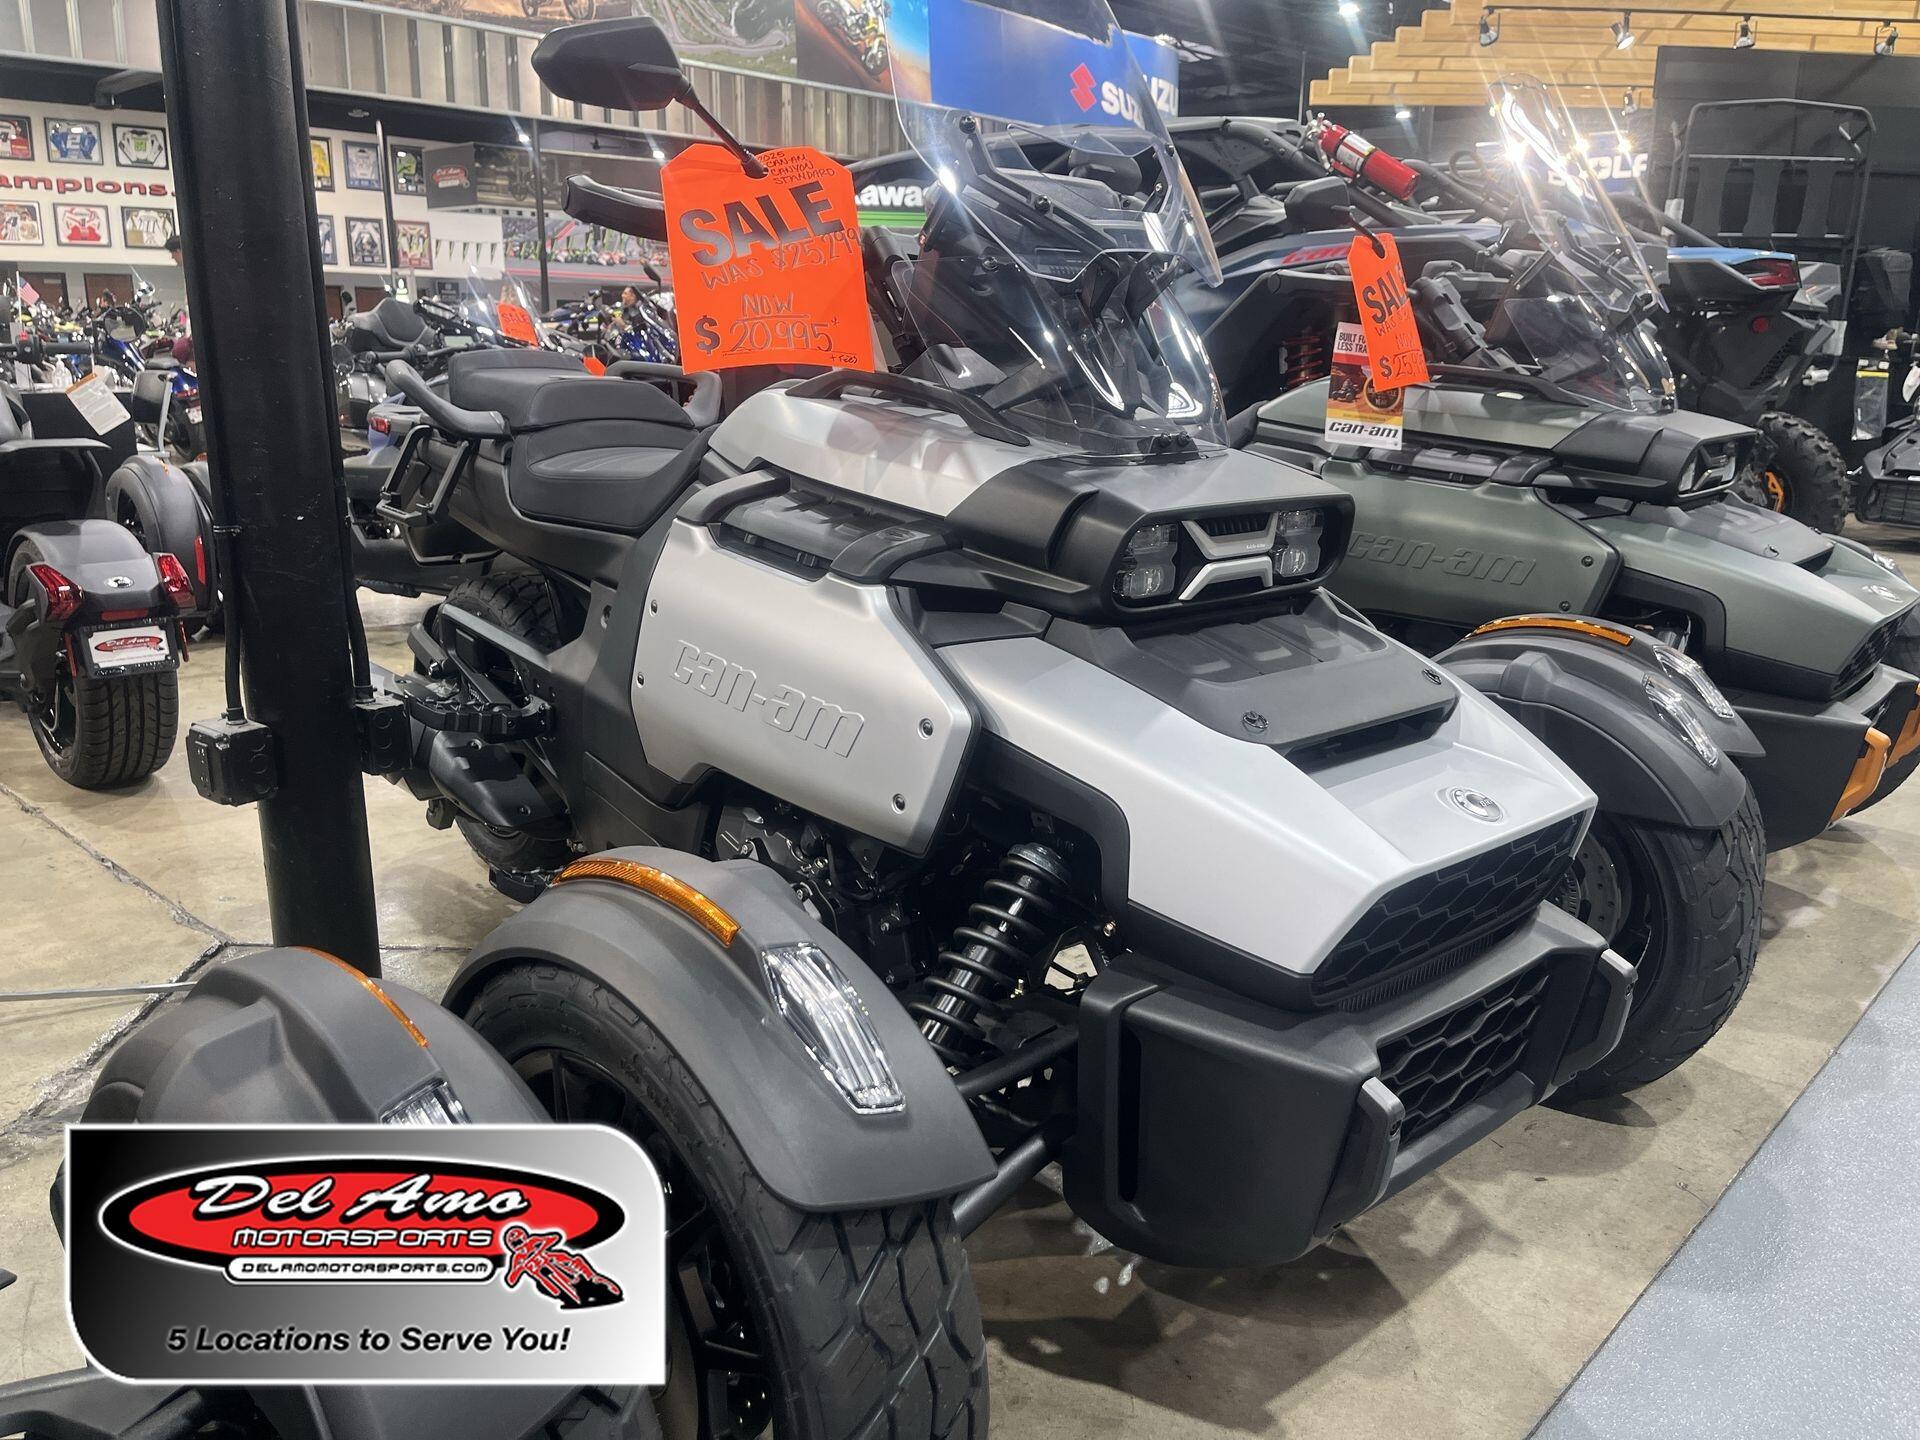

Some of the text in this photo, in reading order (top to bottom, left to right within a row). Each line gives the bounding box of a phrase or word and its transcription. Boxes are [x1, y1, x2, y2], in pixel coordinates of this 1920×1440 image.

[770, 160, 814, 177] CANYON
[773, 168, 836, 185] STANDARD
[679, 180, 845, 267] SALE
[700, 257, 764, 290] WAS
[742, 291, 795, 317] NOW
[1362, 262, 1408, 324] SAL
[695, 314, 721, 355] $
[1337, 341, 1353, 352] LESS
[1338, 332, 1357, 343] BUILT
[1329, 421, 1399, 439] can-am
[1346, 531, 1538, 586] can-am
[670, 639, 866, 759] can-am
